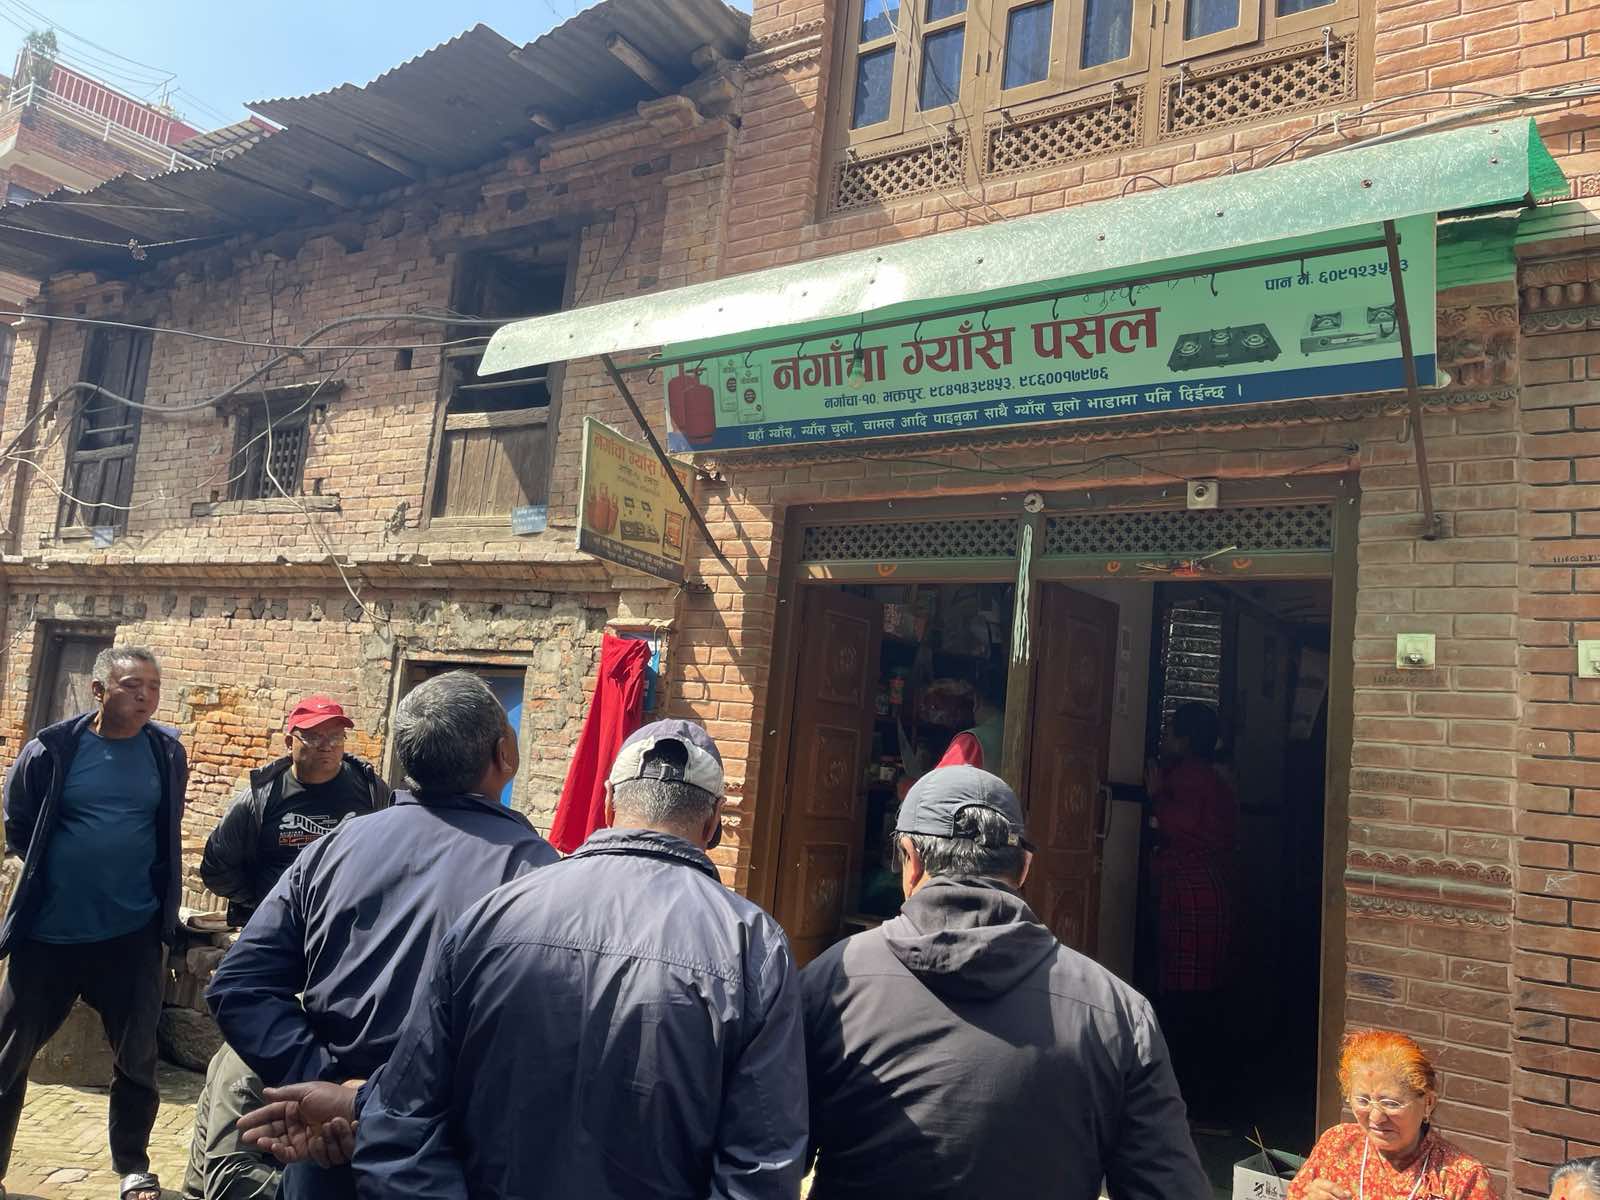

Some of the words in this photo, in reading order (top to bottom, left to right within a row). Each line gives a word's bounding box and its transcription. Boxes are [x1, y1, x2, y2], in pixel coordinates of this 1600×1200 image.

[1265, 275, 1292, 291] पान
[1318, 259, 1409, 284] ६०९१२३५३
[901, 319, 1016, 375] ग्याँस
[1031, 306, 1162, 360] पसल
[862, 417, 895, 430] चामल
[900, 412, 928, 428] आदि
[984, 402, 1009, 420] साथै
[1014, 399, 1046, 416] ग्याँस
[1051, 397, 1082, 416] चुलो
[1087, 394, 1138, 410] भाडामा
[1144, 387, 1172, 404] पनि
[1179, 383, 1227, 401] दिईन्छ
